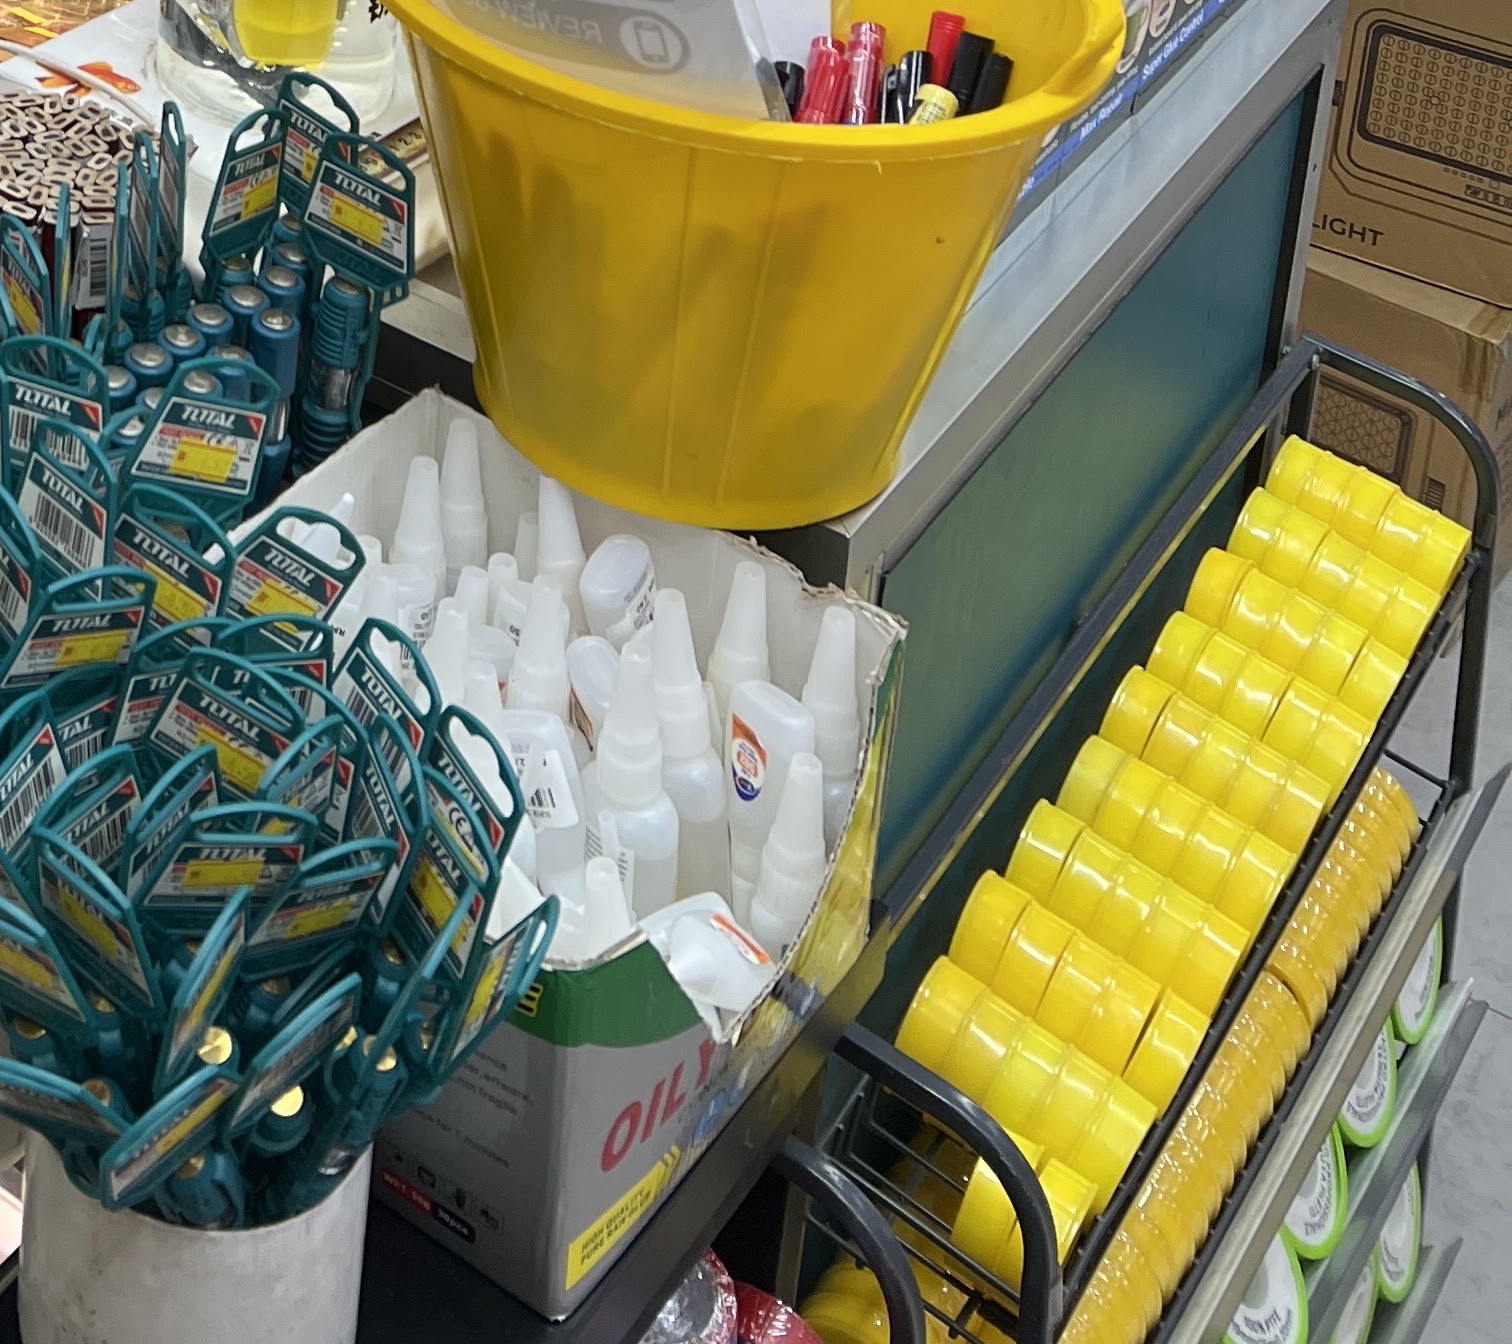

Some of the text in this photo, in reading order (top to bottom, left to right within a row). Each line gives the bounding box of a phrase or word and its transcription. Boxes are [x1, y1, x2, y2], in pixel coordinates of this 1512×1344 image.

[1142, 10, 1205, 80] Super Glue Control
[1079, 93, 1124, 141] Max Repair
[333, 169, 383, 207] TOTAL
[15, 383, 72, 416] TOTAL
[181, 404, 235, 429] TOTAL
[41, 469, 85, 515] TOTAL
[132, 527, 192, 580] TOTAL
[263, 547, 317, 588] TOTAL
[53, 614, 111, 632] TOTAL
[361, 666, 402, 719] TOTAL
[199, 694, 261, 743] TOTAL
[581, 1230, 604, 1252] HIGH
[581, 1245, 606, 1266] PURE
